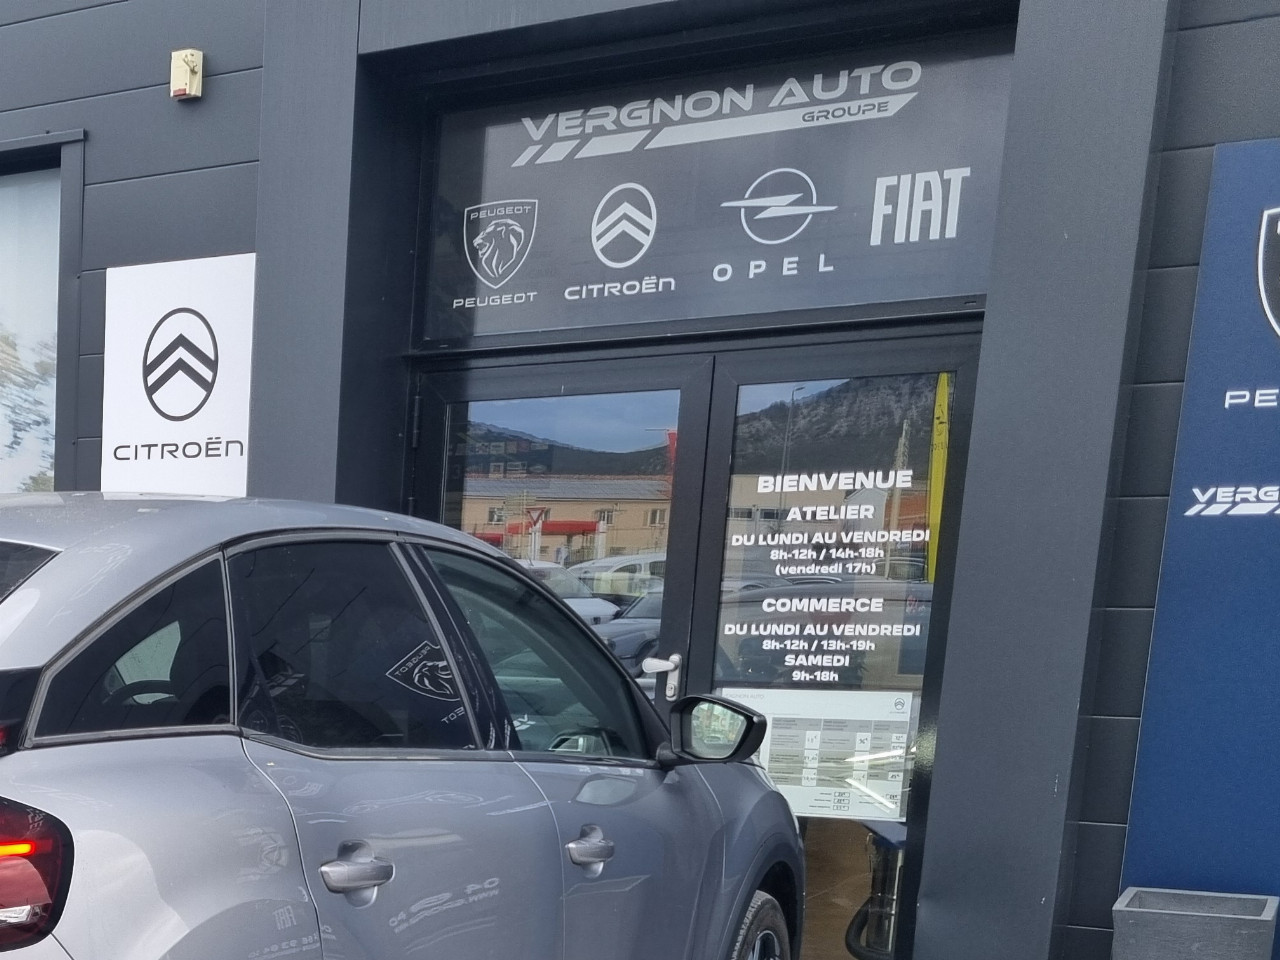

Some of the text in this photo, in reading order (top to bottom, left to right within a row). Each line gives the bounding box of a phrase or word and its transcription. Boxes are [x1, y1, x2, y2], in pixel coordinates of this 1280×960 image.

[521, 60, 922, 142] VERGNON AUTO
[801, 100, 890, 124] GROUPE
[470, 205, 532, 221] PEUGEOT
[870, 166, 971, 246] FIAT
[712, 253, 835, 283] OPEL
[452, 291, 538, 309] PEUGEOT
[757, 469, 913, 493] BIENVENUE
[786, 504, 875, 521] ATELIER
[731, 530, 930, 546] DU LUNDI AU VENDREDI
[770, 547, 884, 560] 8h-12h / 14h-18h
[775, 562, 876, 576] (vendredi 17h)
[762, 598, 884, 613] COMMERCE
[724, 623, 921, 637] DU LUNDI AU VENDREDI
[761, 639, 876, 651] 8h-12h / 13h-19h
[784, 654, 850, 667] SAMEDI
[792, 670, 839, 682] 9h-18h
